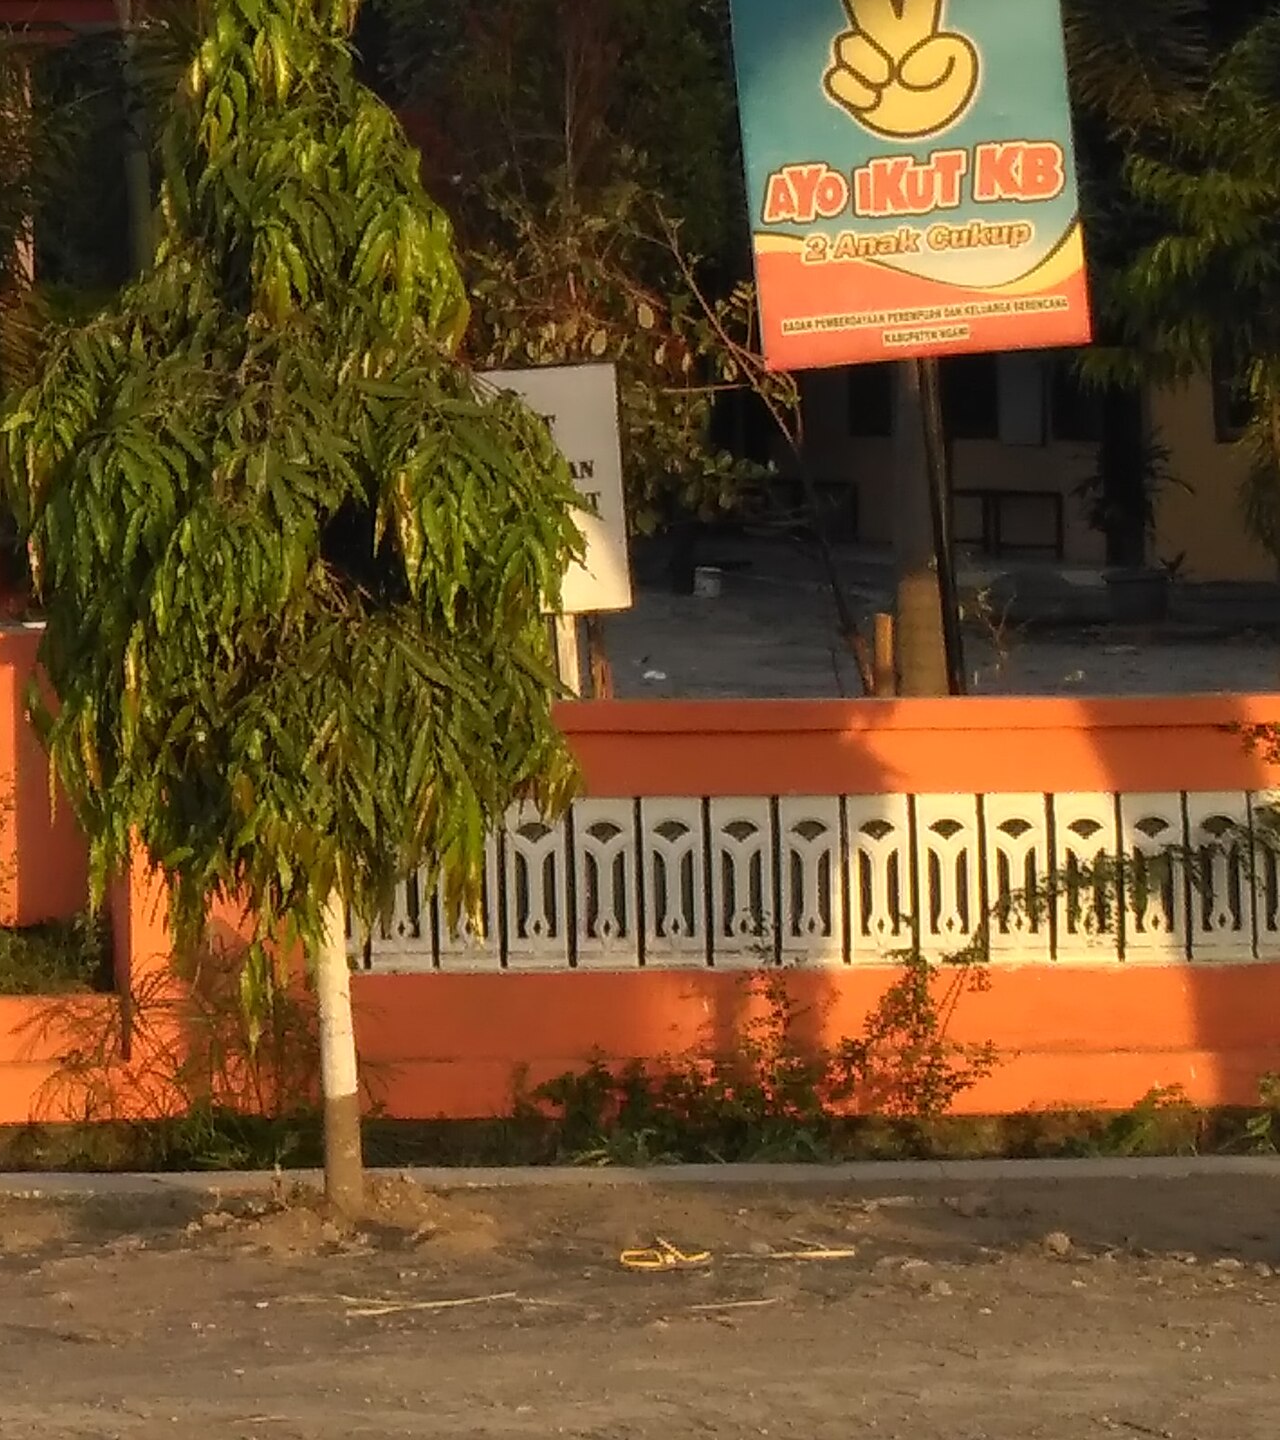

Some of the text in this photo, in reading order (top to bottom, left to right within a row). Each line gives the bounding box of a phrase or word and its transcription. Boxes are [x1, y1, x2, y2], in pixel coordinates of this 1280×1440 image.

[762, 140, 1065, 223] AYO IKUT KB
[804, 221, 1032, 262] 2 Anak Cukup
